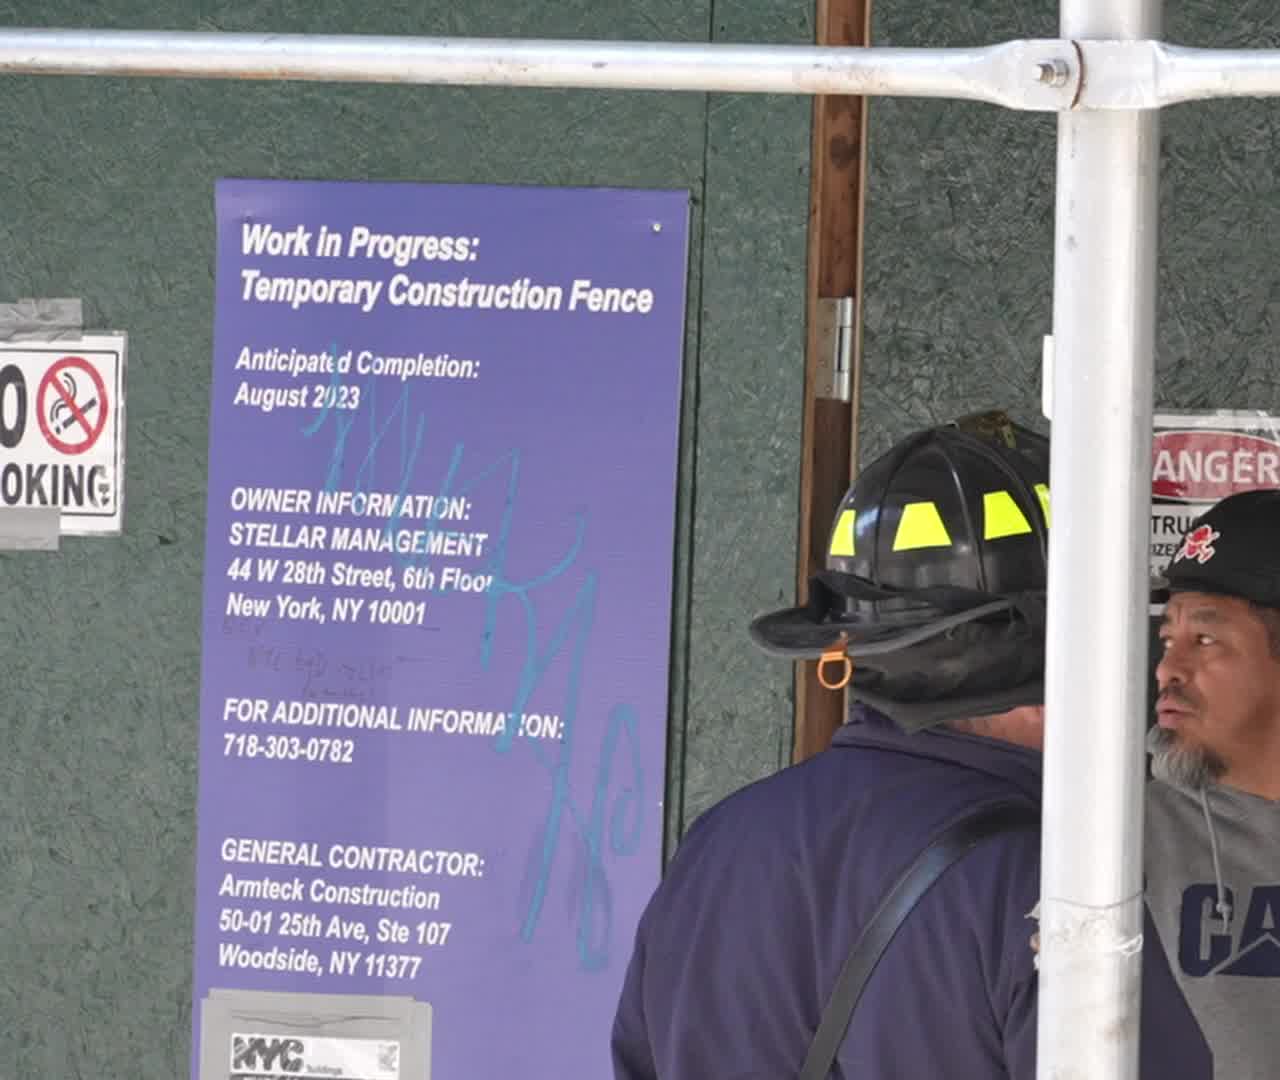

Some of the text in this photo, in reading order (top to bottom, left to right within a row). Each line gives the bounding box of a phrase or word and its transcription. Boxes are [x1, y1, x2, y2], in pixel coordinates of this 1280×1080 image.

[241, 223, 480, 267] Work in Progress:
[240, 269, 655, 313] Temporary Construction Fence
[357, 351, 480, 381] Completion:
[234, 382, 361, 411] August 2023
[1152, 450, 1280, 484] ANGER
[230, 487, 471, 520] OWNER INFORMATION:
[229, 522, 488, 557] STELLAR MANAGEMENT
[227, 558, 493, 593] 44 W 28th Street, 6th Floor
[225, 593, 427, 625] New York, NY 10001
[223, 698, 565, 739] FOR ADDITIONAL INFORMAION:
[223, 734, 354, 763] 718-303-0782
[221, 838, 485, 877] GENERAL CONTRACTOR:
[219, 873, 440, 911] Armteck Construction
[219, 909, 451, 945] 50-01 25th Ave, Ste 107
[219, 943, 422, 980] Woodside, NY 11377
[233, 1036, 304, 1072] NYC
